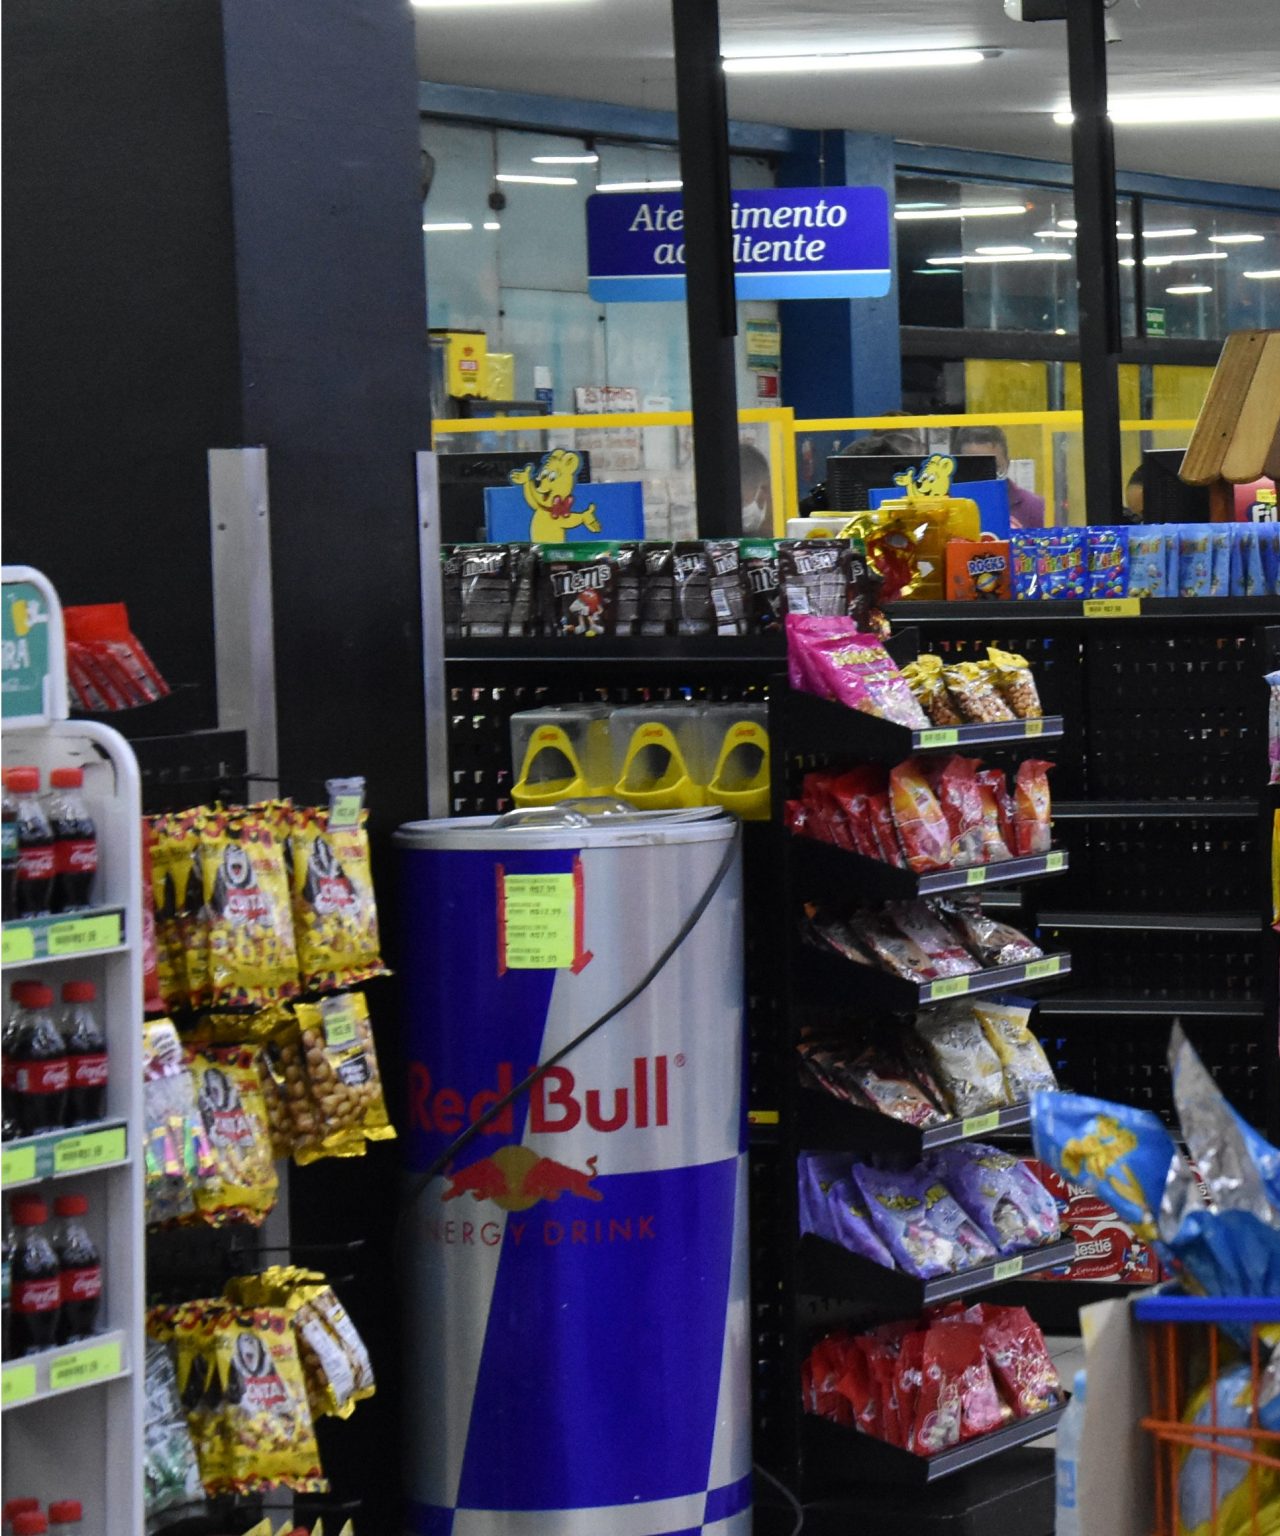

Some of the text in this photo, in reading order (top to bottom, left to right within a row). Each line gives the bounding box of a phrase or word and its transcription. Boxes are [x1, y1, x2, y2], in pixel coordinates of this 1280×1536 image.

[732, 234, 826, 263] liente
[968, 556, 1006, 575] ROCKS
[408, 1056, 668, 1134] Red Bull
[429, 1215, 656, 1246] NERGY DRINK
